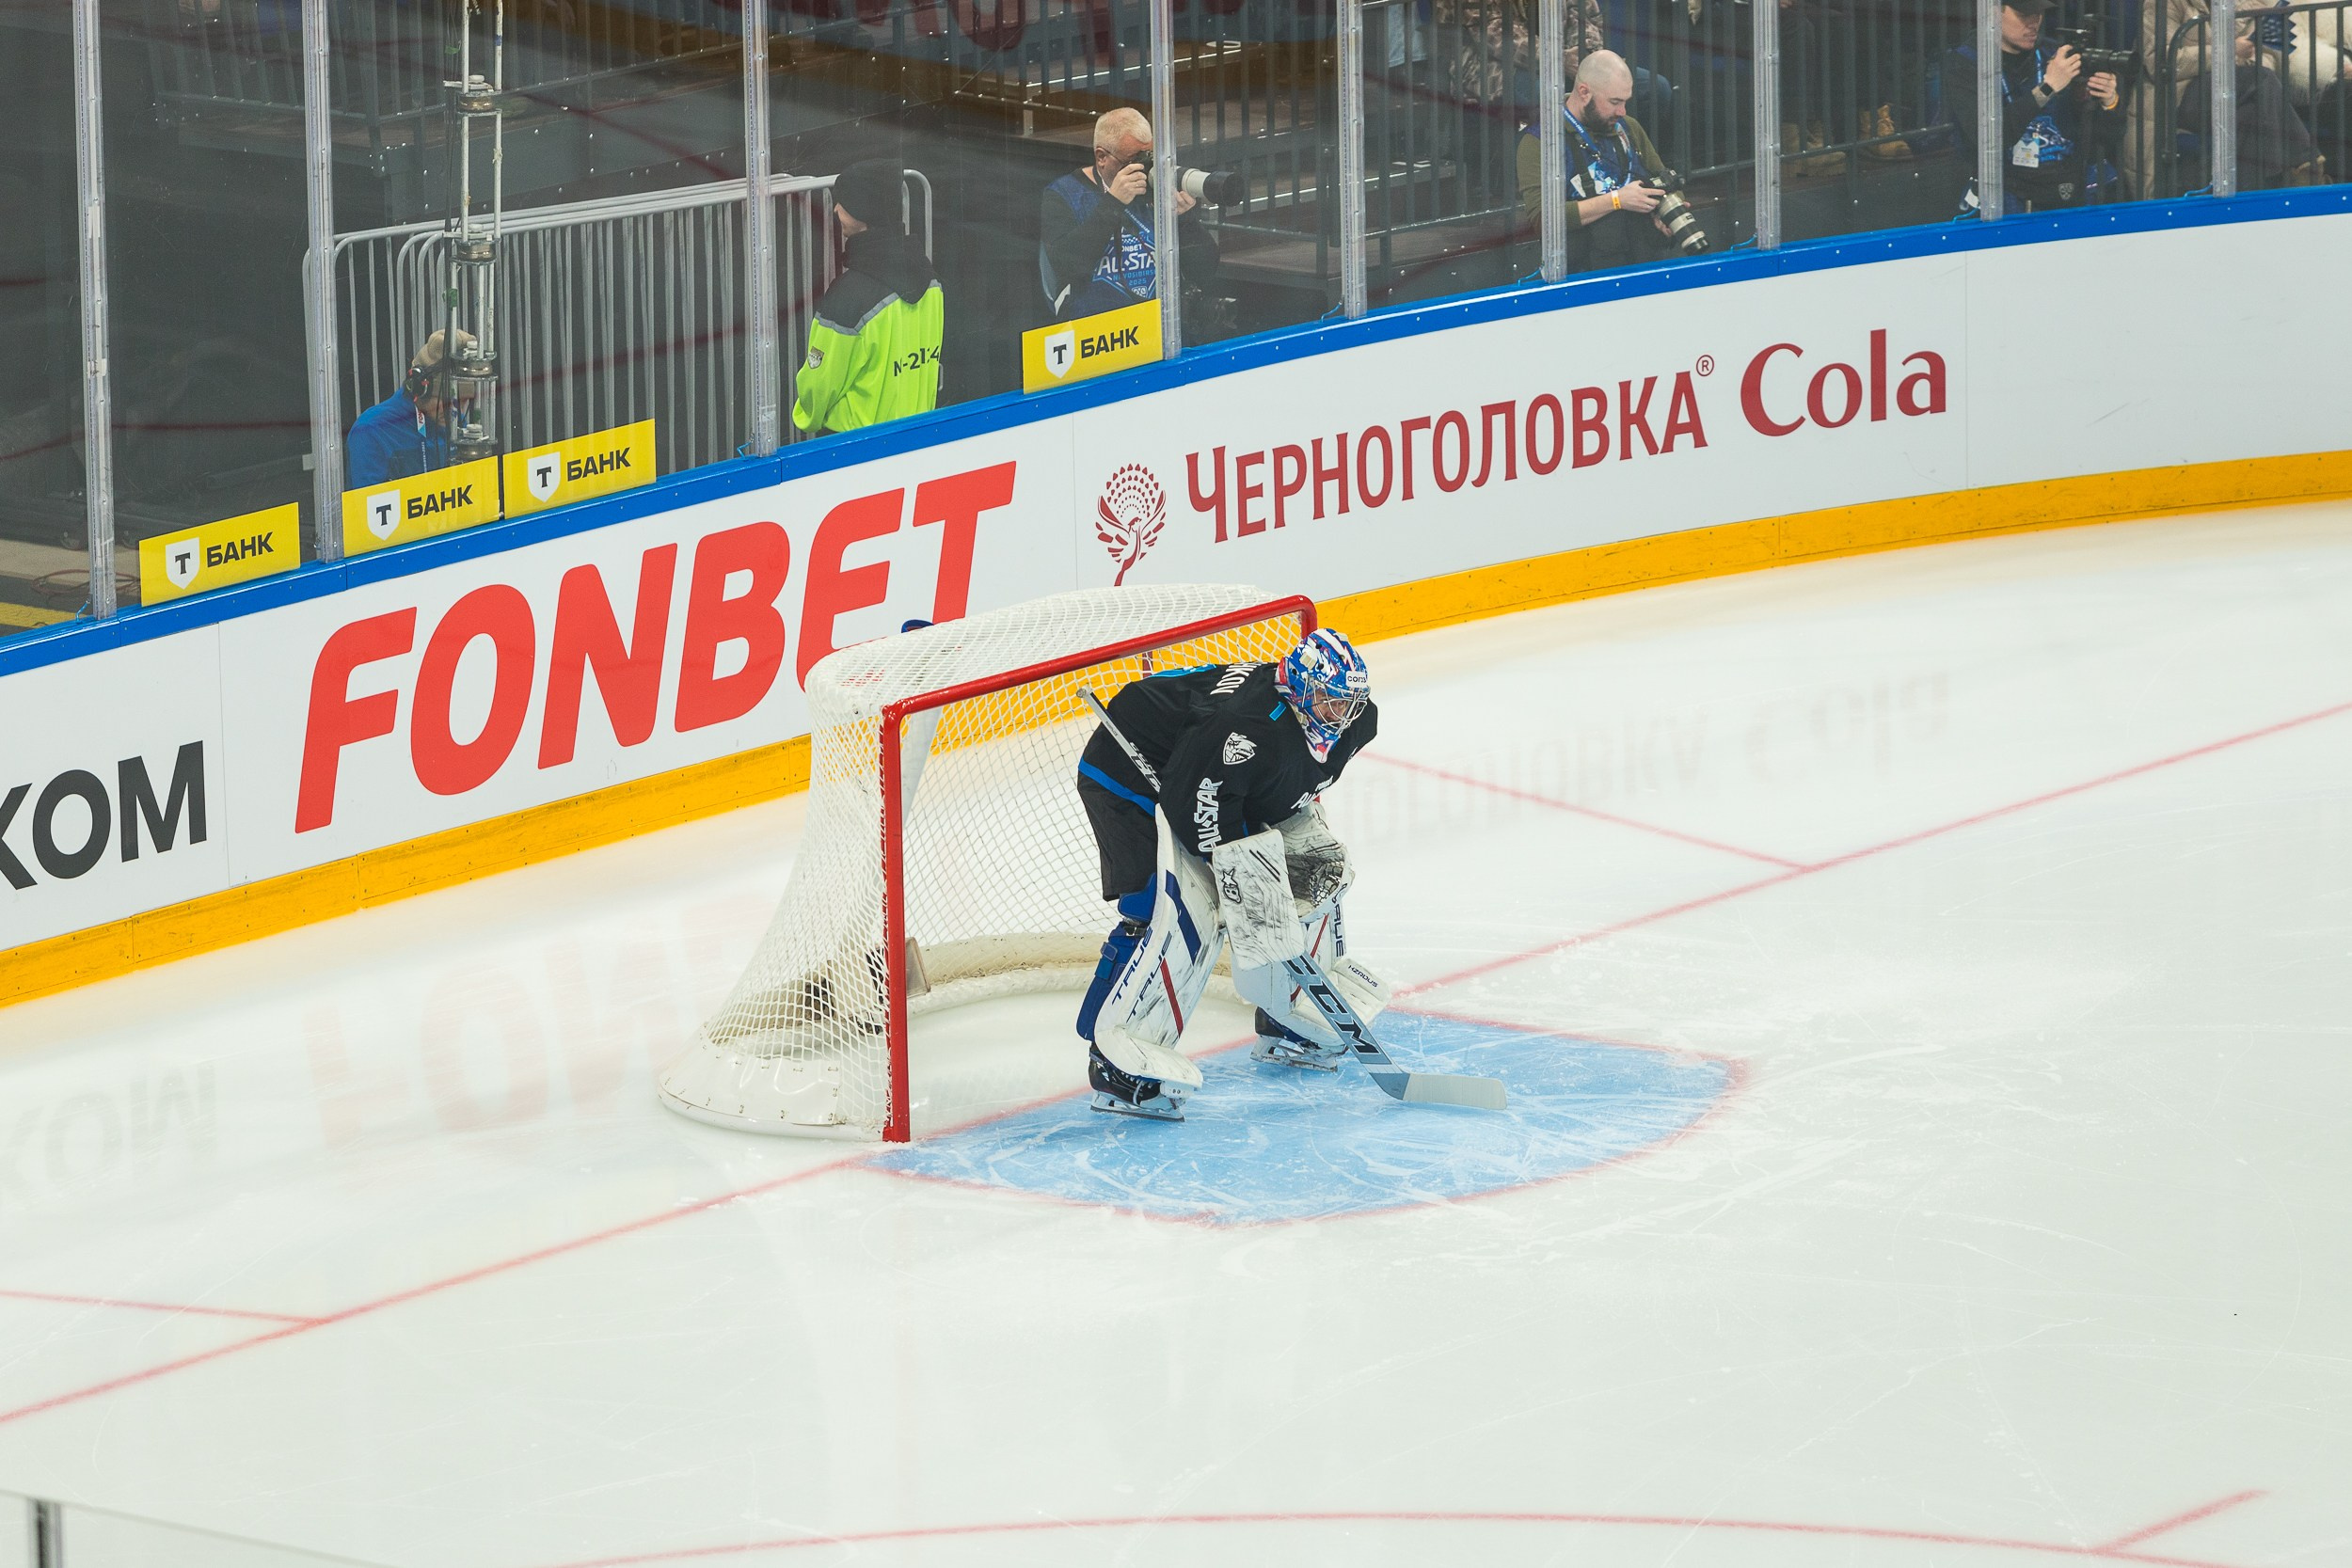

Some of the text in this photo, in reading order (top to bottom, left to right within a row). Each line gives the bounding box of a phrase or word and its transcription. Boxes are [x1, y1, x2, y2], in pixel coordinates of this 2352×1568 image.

[1080, 326, 1139, 359] БАНК
[1740, 329, 1947, 436] Cola
[566, 448, 631, 482] БАНК
[406, 484, 473, 520] БАНК
[206, 531, 274, 568] БАНК
[295, 461, 1017, 835] FONBET
[1111, 926, 1153, 1006] TRUE
[1126, 930, 1173, 1023] TRUE
